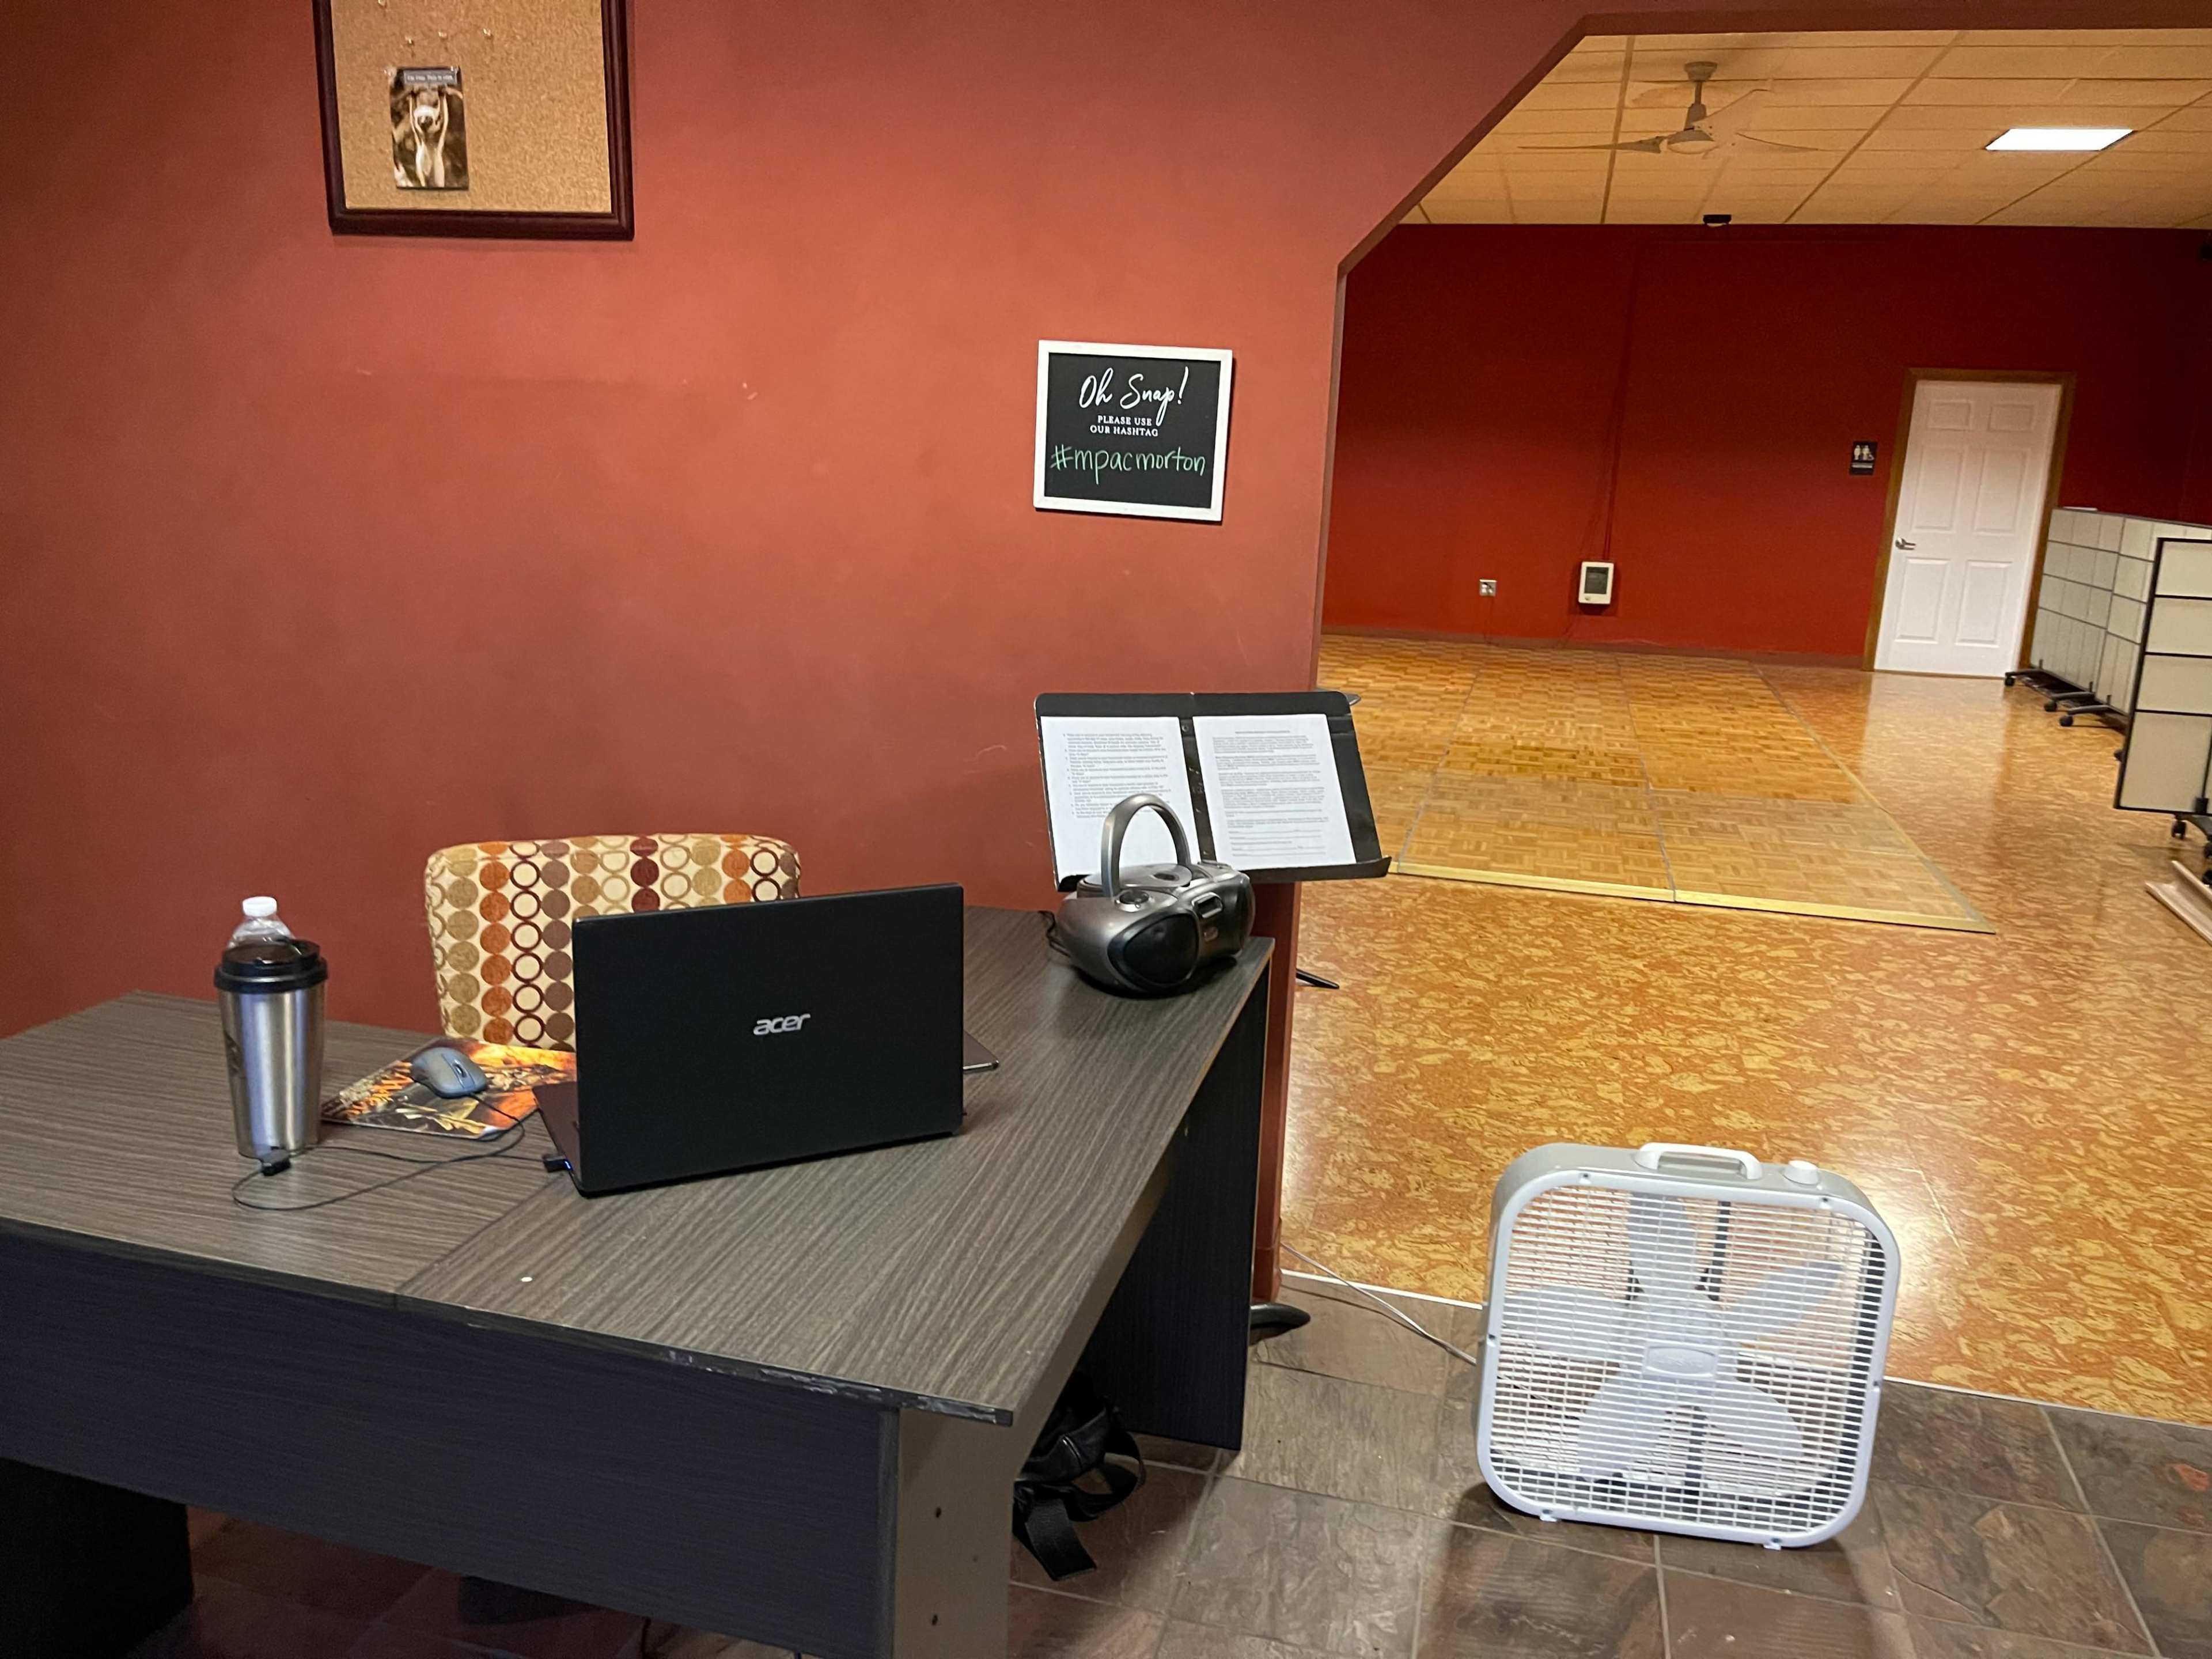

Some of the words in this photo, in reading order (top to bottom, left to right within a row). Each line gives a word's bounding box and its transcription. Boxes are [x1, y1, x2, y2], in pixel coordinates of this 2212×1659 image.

[1080, 367, 1114, 408] Oh
[1120, 366, 1189, 427] Snap!
[1090, 425, 1111, 434] OUR
[1113, 427, 1158, 437] HASHTAG
[1097, 415, 1131, 426] PLEASE
[1134, 417, 1152, 426] USE
[1050, 444, 1206, 485] #mpacmorton
[753, 1013, 811, 1035] acer
